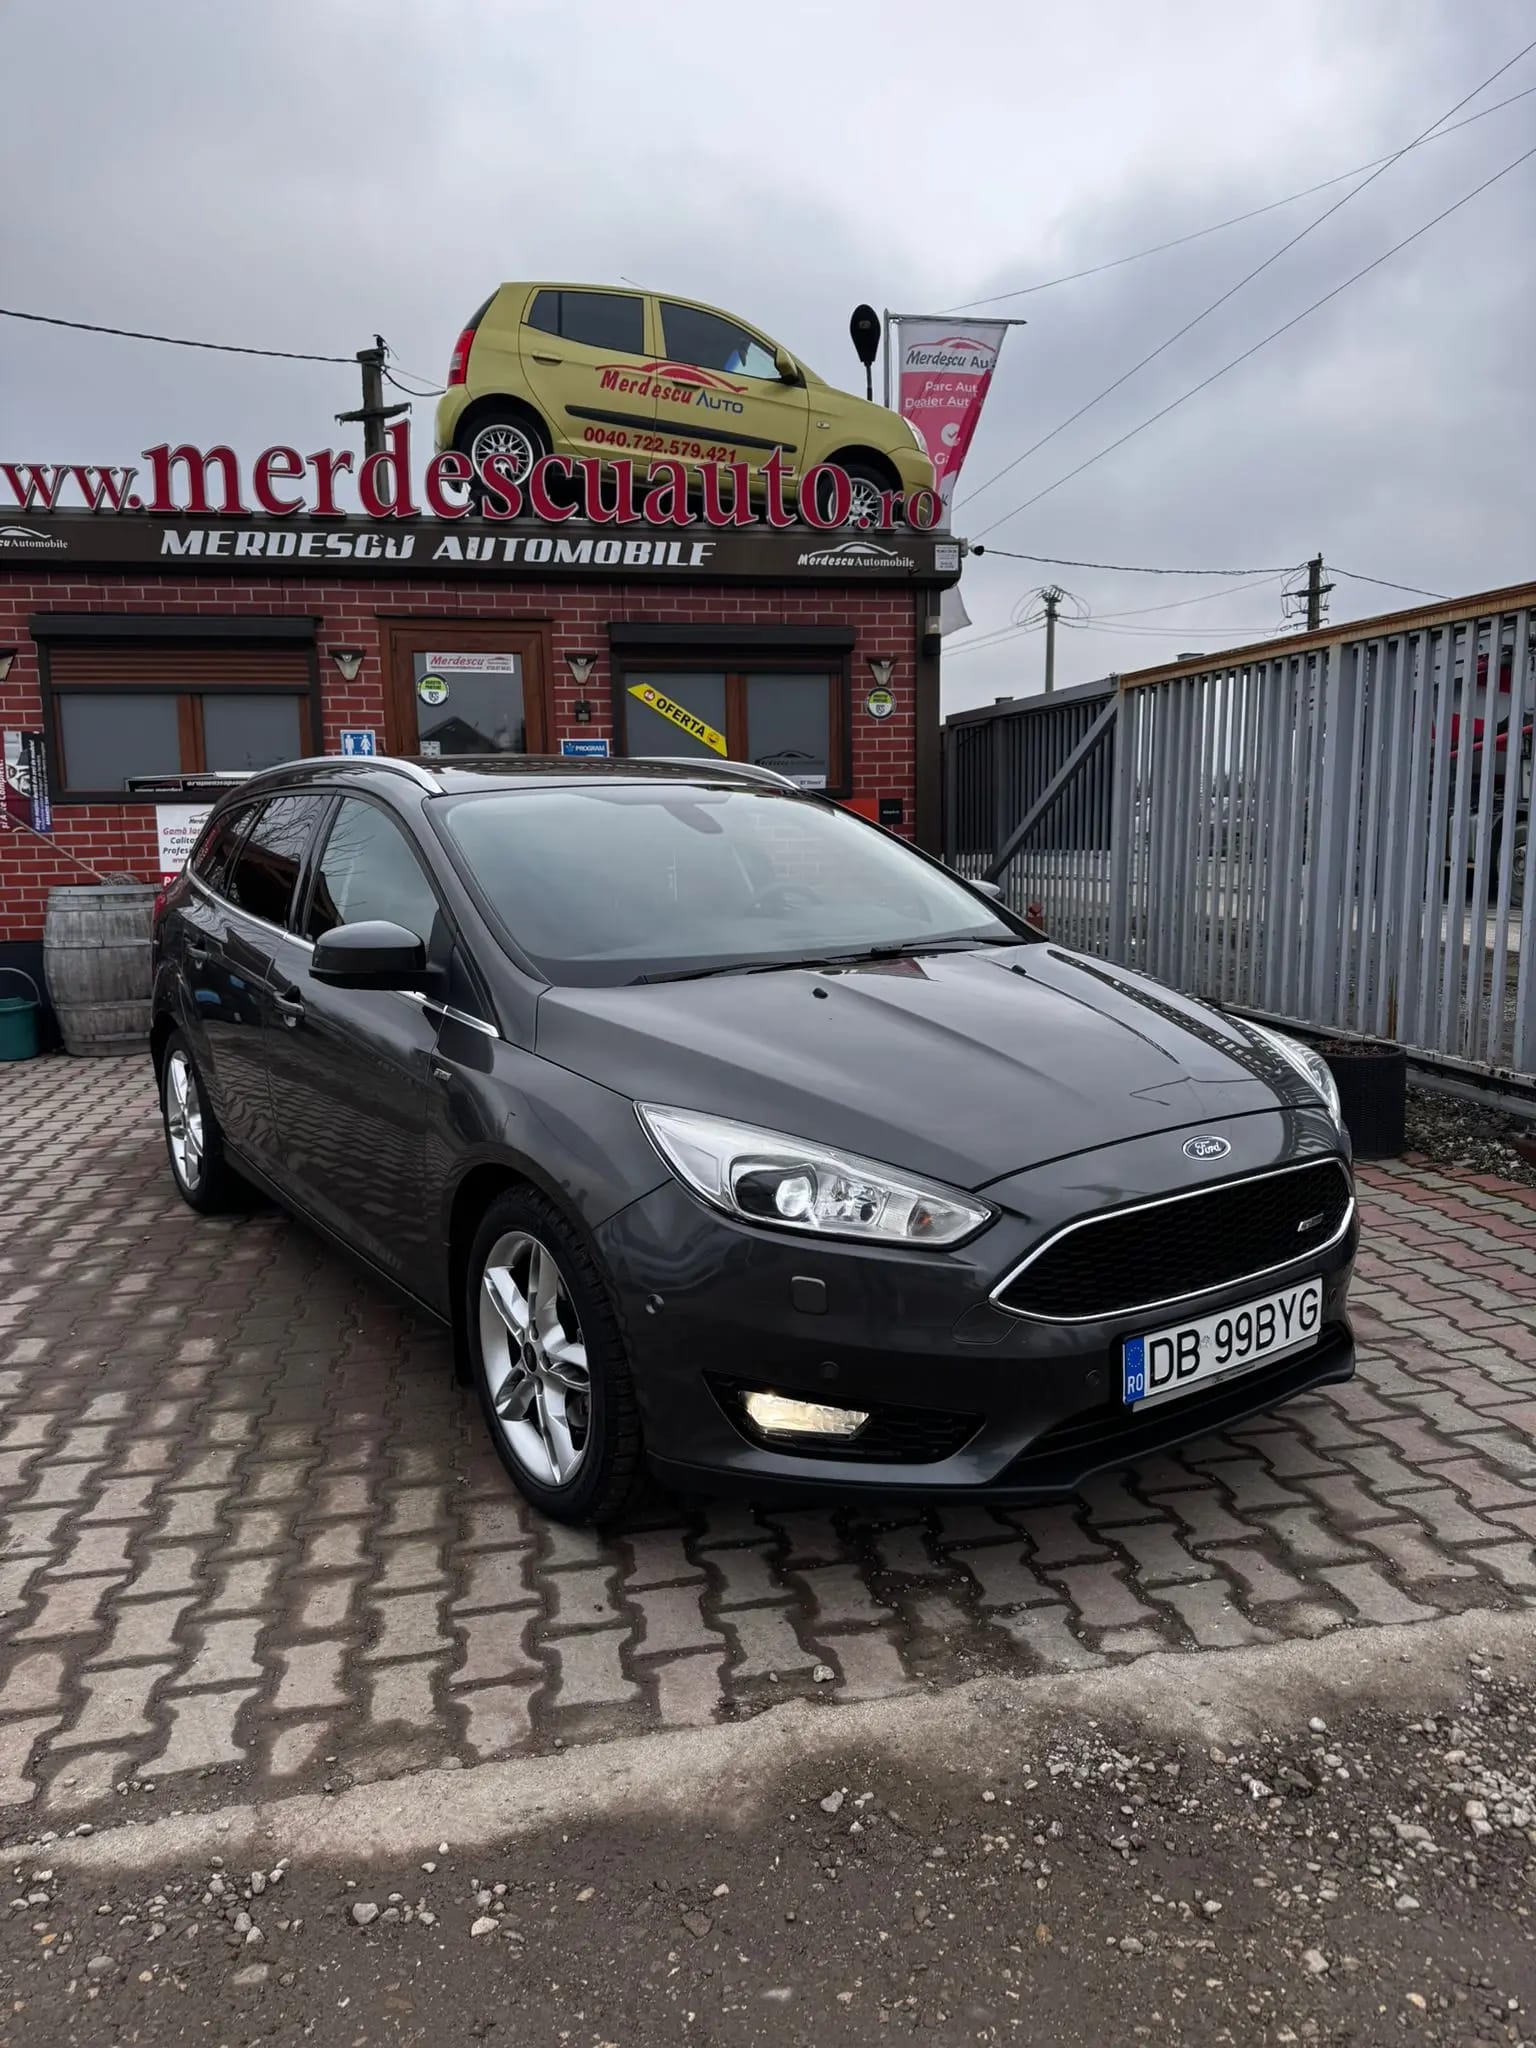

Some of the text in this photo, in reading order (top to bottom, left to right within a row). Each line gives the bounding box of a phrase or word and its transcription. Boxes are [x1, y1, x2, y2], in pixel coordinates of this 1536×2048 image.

[906, 350, 967, 367] Merdescu
[599, 369, 744, 414] Merdescu AUTO
[925, 381, 978, 393] Parc Aut
[905, 396, 970, 408] Dealer Aut
[584, 427, 736, 463] 0040.722.579.421
[432, 535, 717, 567] AUTOMOBILE
[430, 655, 485, 666] Merdescu
[656, 697, 706, 739] OFERTA
[575, 744, 606, 752] PROGRAM
[1194, 1140, 1221, 1156] Ford
[1149, 1287, 1319, 1388] DB 99BYG
[1127, 1373, 1143, 1395] RO
